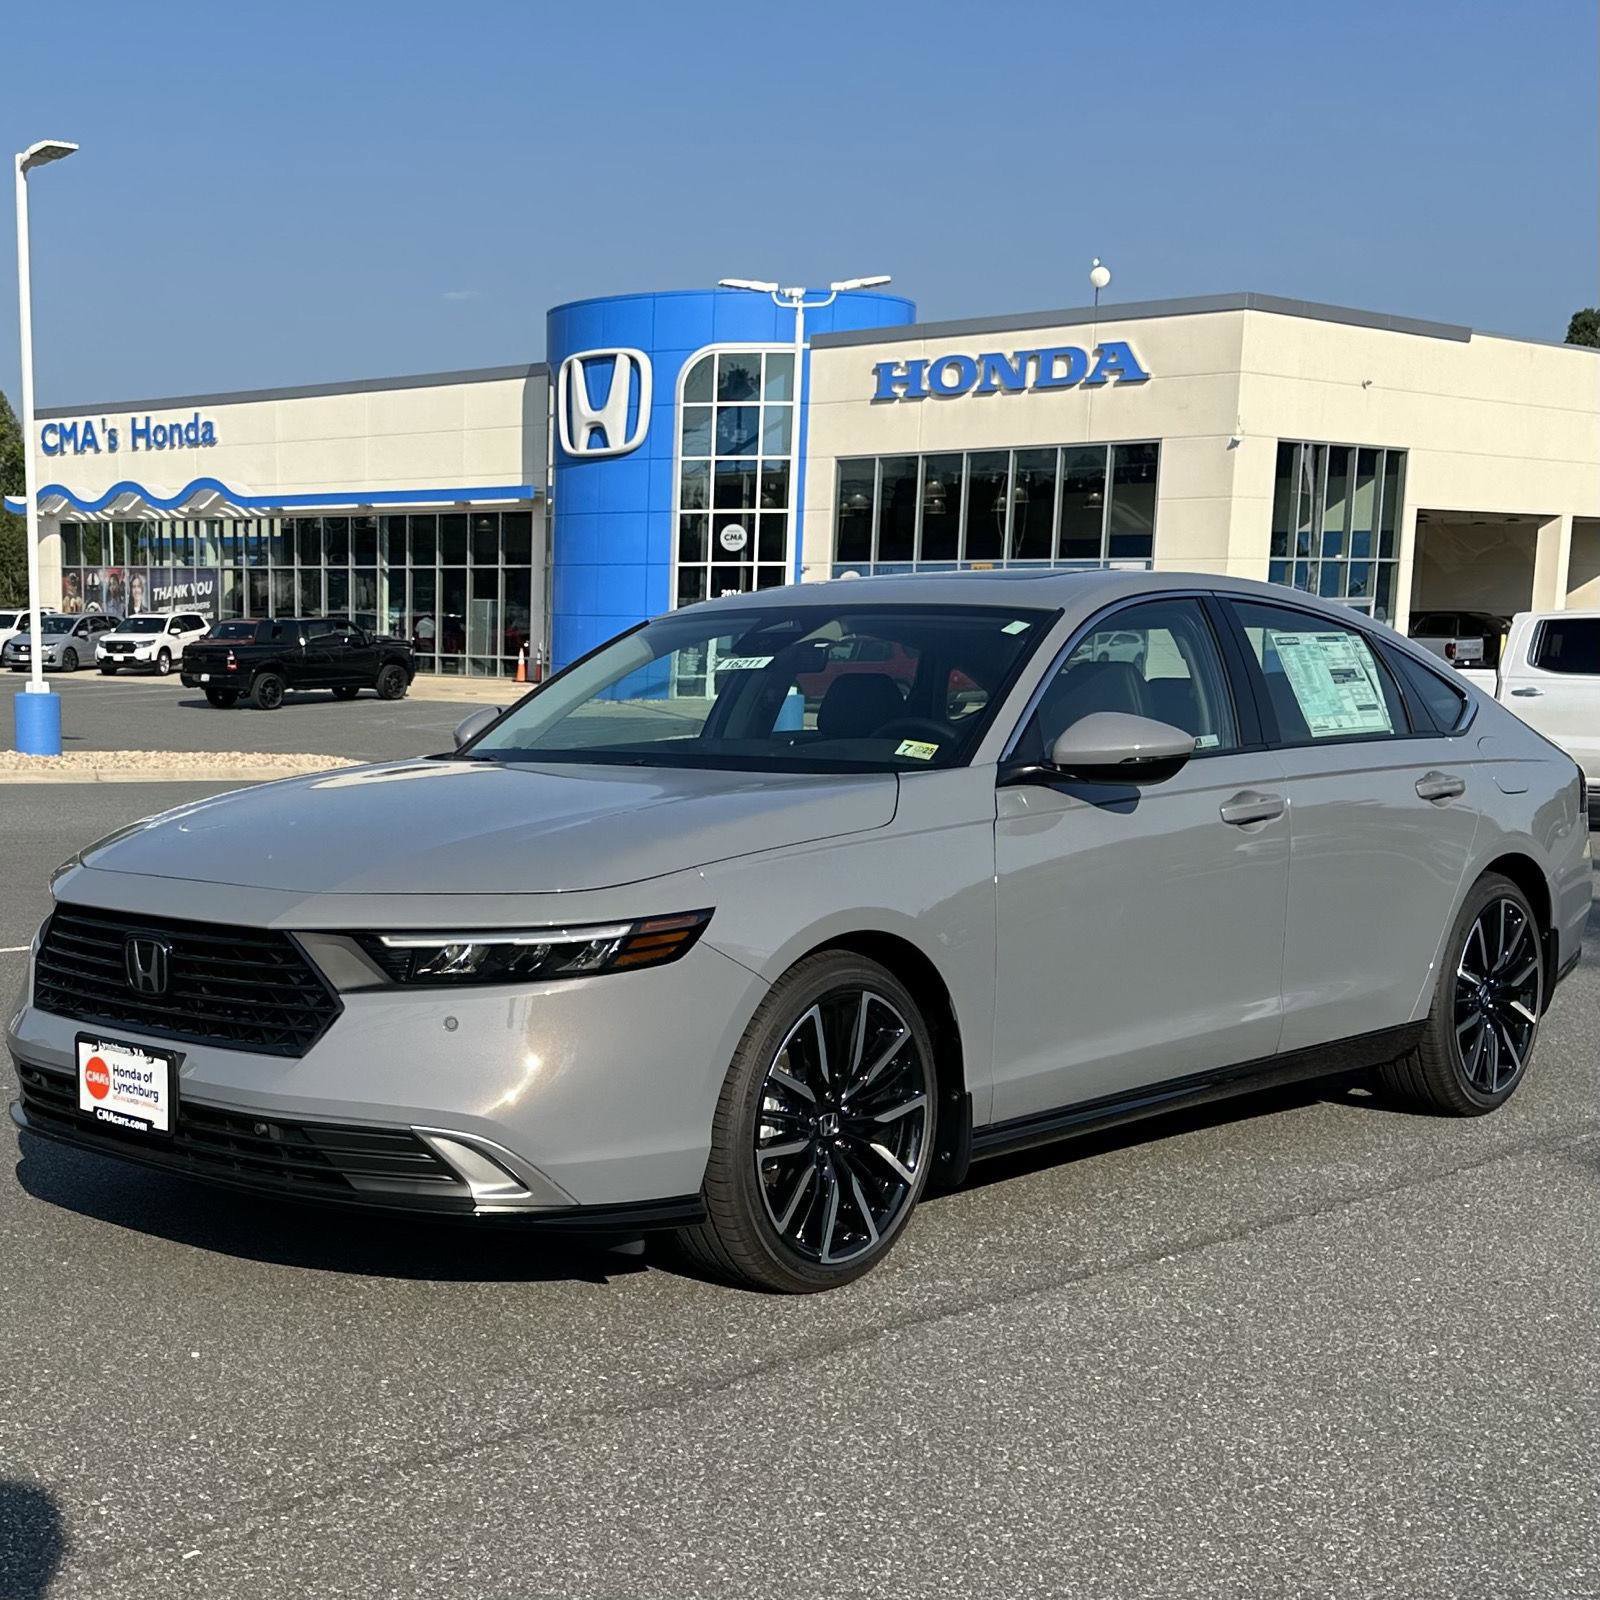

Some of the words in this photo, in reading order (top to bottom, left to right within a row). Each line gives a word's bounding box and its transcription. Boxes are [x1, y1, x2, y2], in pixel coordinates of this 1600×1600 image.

[871, 341, 1150, 404] HONDA
[41, 418, 119, 456] CMA's
[131, 412, 217, 451] Honda
[723, 533, 744, 542] CMA
[153, 583, 189, 601] THANK
[190, 580, 213, 597] YOU
[725, 658, 764, 669] 16211
[903, 744, 914, 753] 7
[112, 1064, 142, 1080] Honda
[143, 1071, 153, 1084] of
[112, 1078, 159, 1103] Lynchburg
[96, 1109, 148, 1131] CMAcars.com
